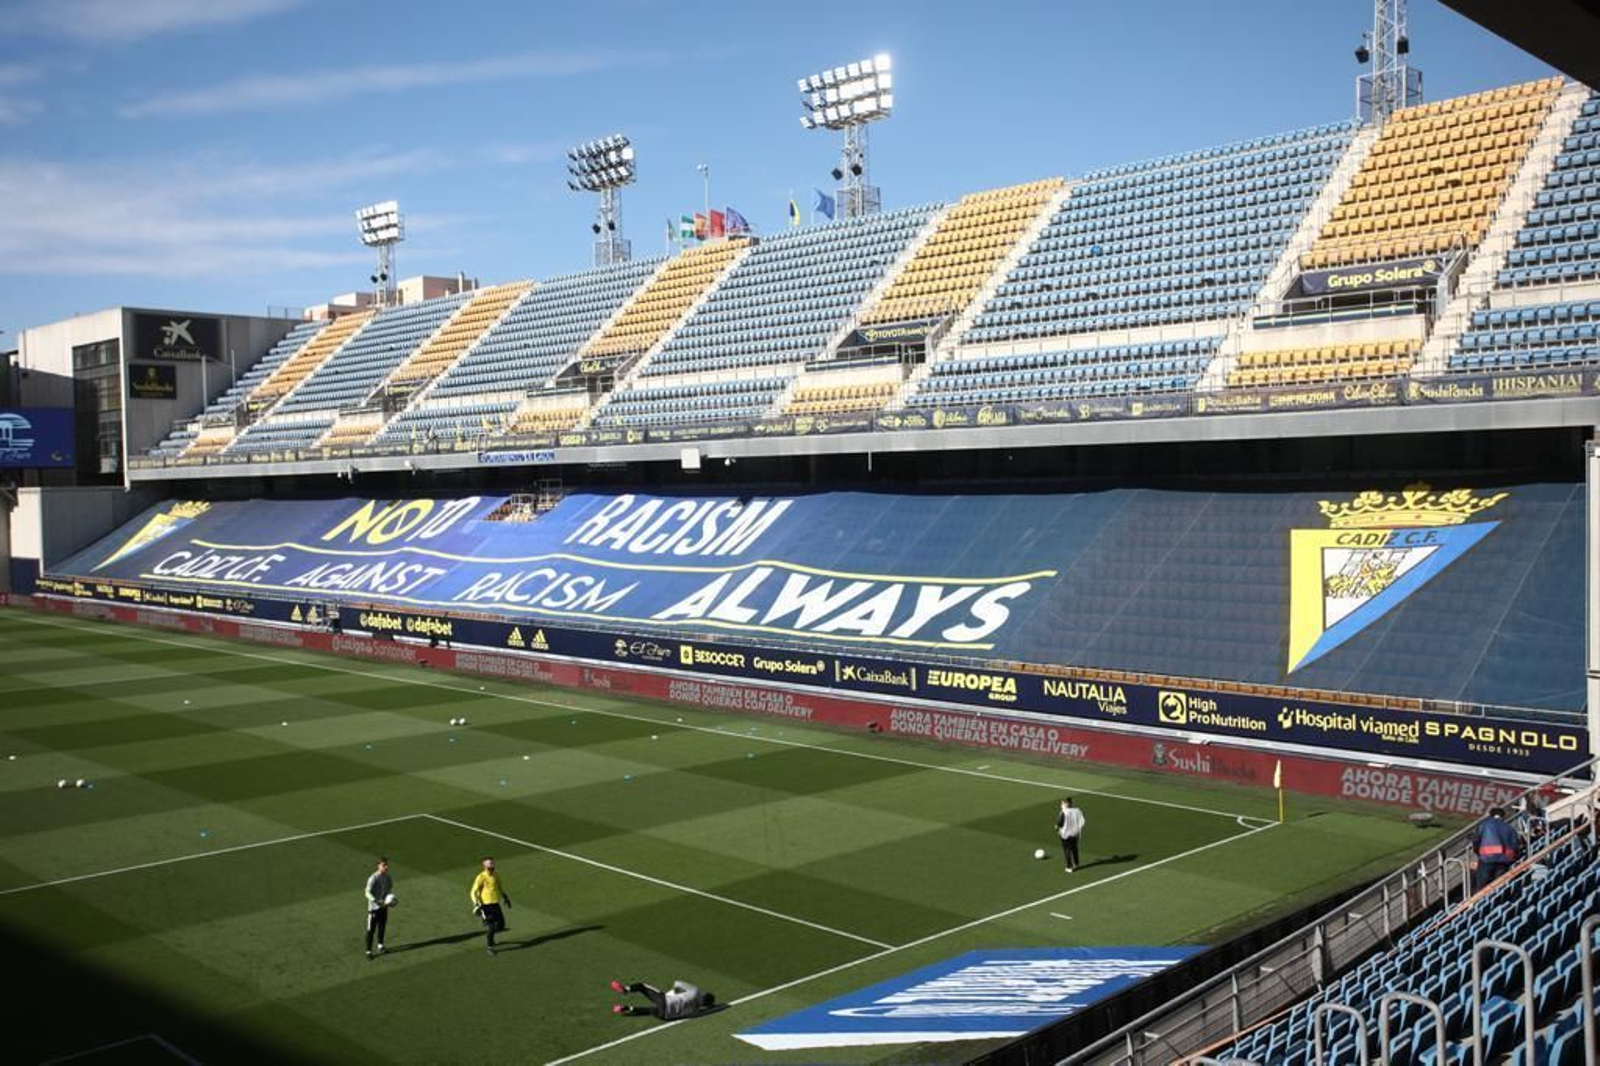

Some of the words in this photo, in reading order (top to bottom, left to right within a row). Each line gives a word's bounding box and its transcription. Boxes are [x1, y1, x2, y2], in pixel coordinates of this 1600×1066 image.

[1328, 273, 1372, 288] Grupo
[1375, 266, 1424, 283] Solera
[320, 498, 435, 544] NO
[564, 494, 794, 556] RACISM
[1335, 532, 1400, 546] CADIZ
[1405, 530, 1438, 544] C.F.
[286, 562, 450, 593] AGAINST
[452, 568, 640, 612] RACISM
[650, 567, 1031, 643] ALWAYS
[367, 612, 402, 630] dafabet
[414, 617, 452, 636] dafabet
[695, 649, 745, 668] BESOCCER
[753, 657, 784, 673] Grupo
[785, 659, 818, 675] Solera
[857, 665, 909, 686] CaixaBank
[927, 669, 1017, 693] EUROPEA
[669, 680, 700, 692] AHORA
[744, 689, 757, 699] EN
[759, 690, 784, 703] CASA
[786, 695, 793, 704] O
[988, 692, 1017, 702] GROUP
[1043, 680, 1127, 704] NAUTALIA
[1189, 697, 1217, 711] High
[669, 690, 700, 702] DONDE
[702, 694, 742, 708] QUIERAS
[744, 700, 765, 711] CON
[767, 701, 813, 719] DELIVERY
[1098, 700, 1127, 716] Viajes
[890, 709, 930, 724] AHORA
[933, 711, 987, 732] TAMBIÉN
[990, 721, 1007, 734] EN
[1010, 723, 1045, 740] CASA
[1048, 729, 1059, 741] O
[1295, 708, 1356, 731] Hospital
[1360, 716, 1419, 738] viamed
[890, 720, 931, 735] DONDE
[934, 725, 988, 743] QUIERAS
[990, 733, 1018, 748] CON
[1021, 736, 1089, 757] DELIVERY
[1425, 721, 1577, 750] SPAGNOLO
[1468, 743, 1501, 753] DESDE
[1168, 748, 1210, 773] Sushi
[1341, 768, 1412, 789] AHORA
[1417, 777, 1513, 803] TAMBIÉN
[1342, 781, 1412, 803] DONDE
